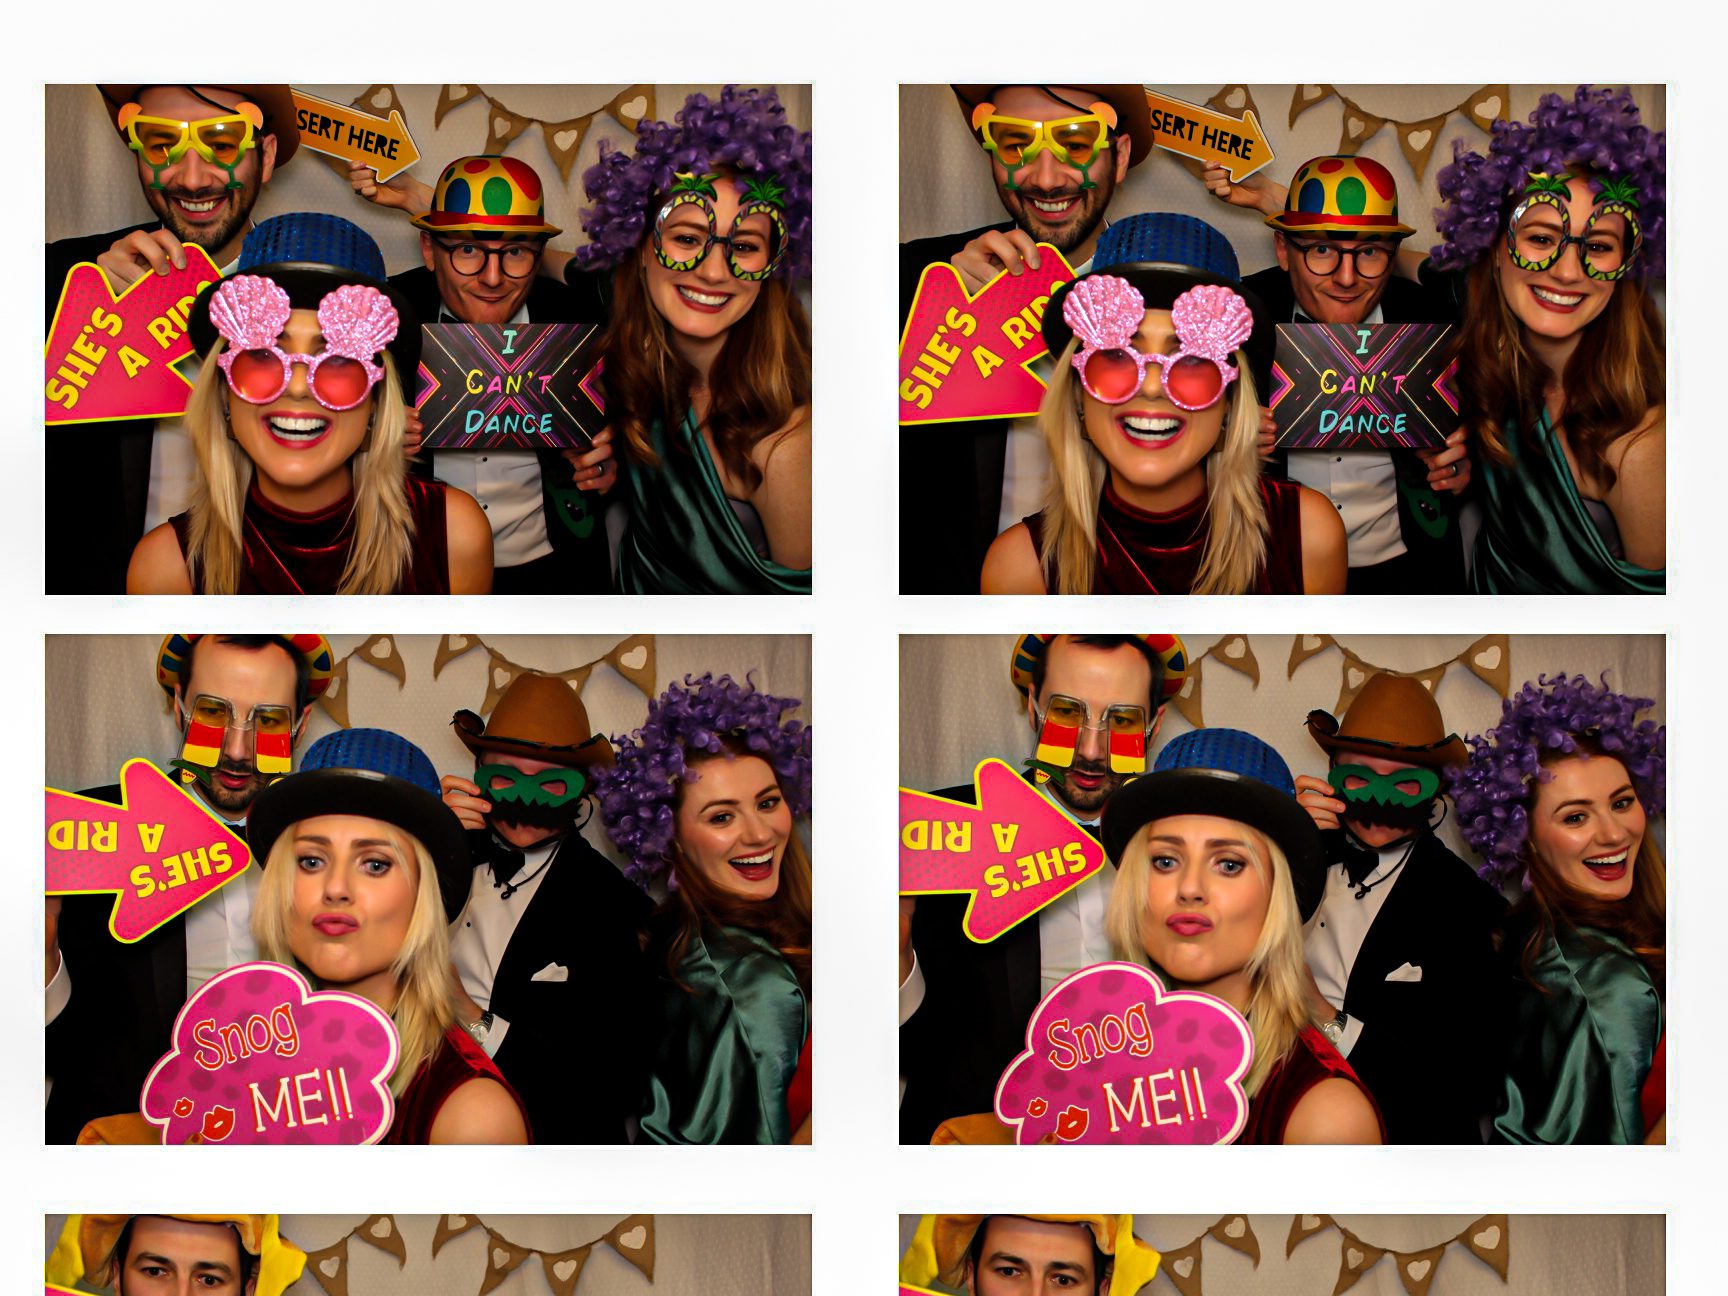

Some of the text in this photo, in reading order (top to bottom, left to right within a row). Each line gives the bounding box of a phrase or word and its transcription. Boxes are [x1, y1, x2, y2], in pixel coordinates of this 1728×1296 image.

[295, 107, 400, 160] SERT HERE
[1149, 107, 1254, 160] SERT HERE
[46, 306, 123, 410] SHE'S
[117, 345, 150, 379] A
[501, 329, 518, 354] I
[900, 306, 977, 410] SHE'S
[971, 345, 1004, 379] A
[1355, 329, 1372, 354] I
[466, 369, 552, 394] CAN'T
[1320, 369, 1406, 394] CAN'T
[465, 409, 553, 434] DANCE
[1319, 409, 1407, 434] DANCE
[137, 823, 165, 853] A
[991, 823, 1019, 853] A
[130, 842, 233, 898] SHE'S
[984, 842, 1087, 898] SHE'S
[193, 1002, 300, 1071] Snog
[1047, 1002, 1154, 1071] Snog
[248, 1067, 354, 1132] ME!!
[1102, 1067, 1208, 1132] ME!!
